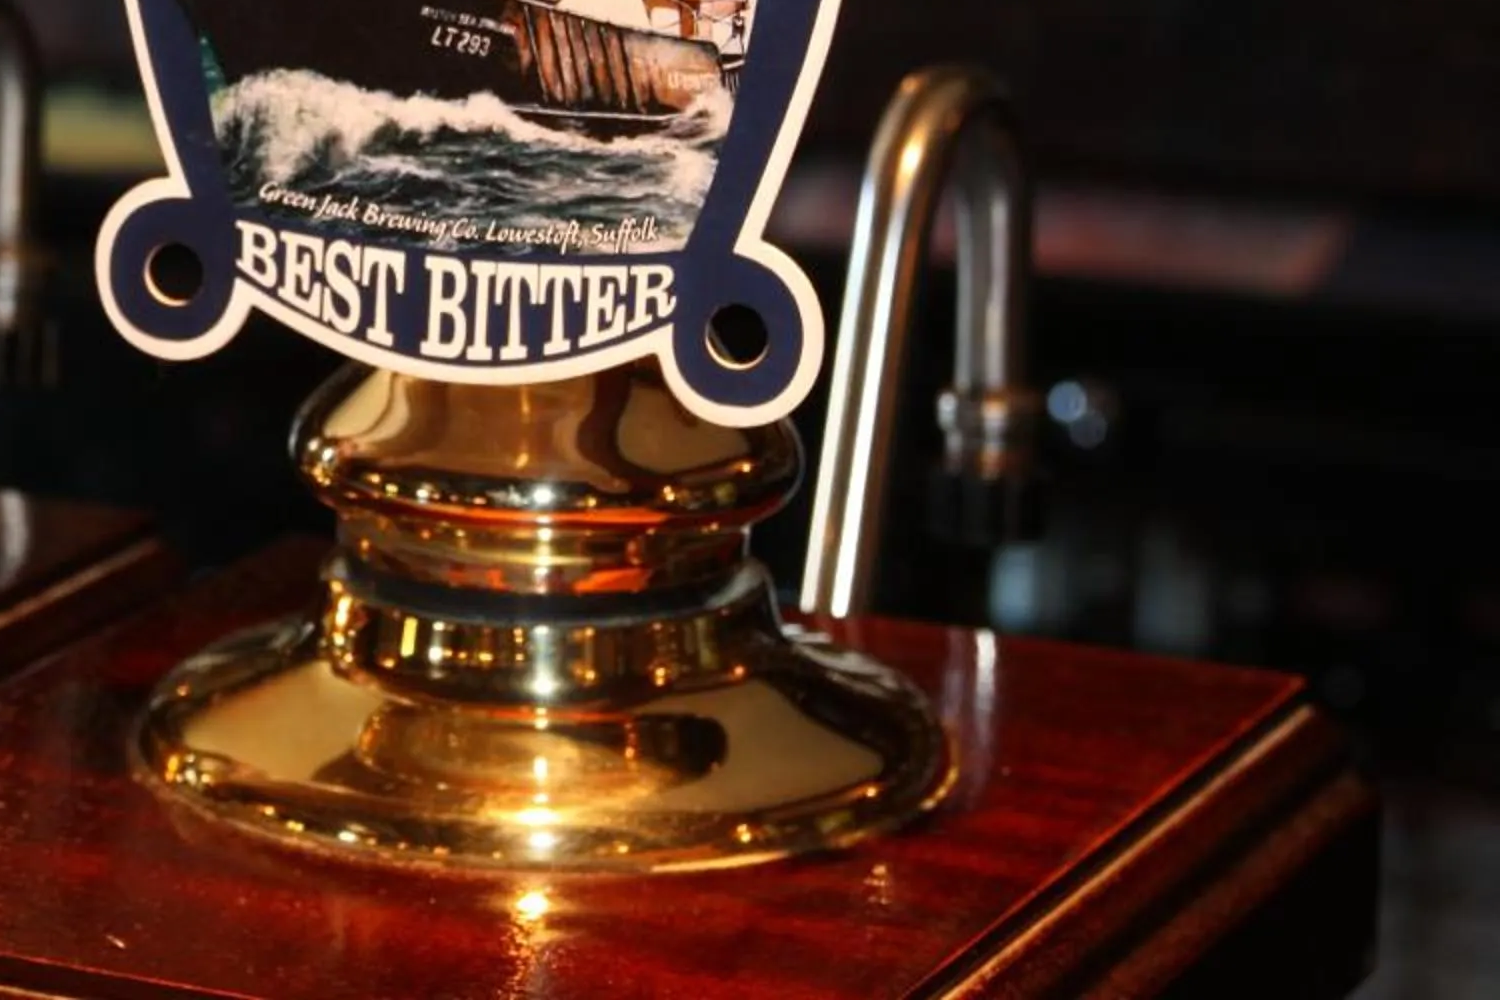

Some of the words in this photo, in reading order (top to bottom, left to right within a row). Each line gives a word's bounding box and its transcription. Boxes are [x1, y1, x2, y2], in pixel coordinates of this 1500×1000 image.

[259, 180, 316, 212] Green
[313, 193, 360, 221] Jack
[362, 202, 447, 242] Brewing
[451, 215, 480, 239] Co.
[485, 218, 583, 256] Lowestoft,
[590, 214, 660, 254] Suffolk
[235, 219, 406, 348] BEST
[419, 250, 677, 361] BITTER
